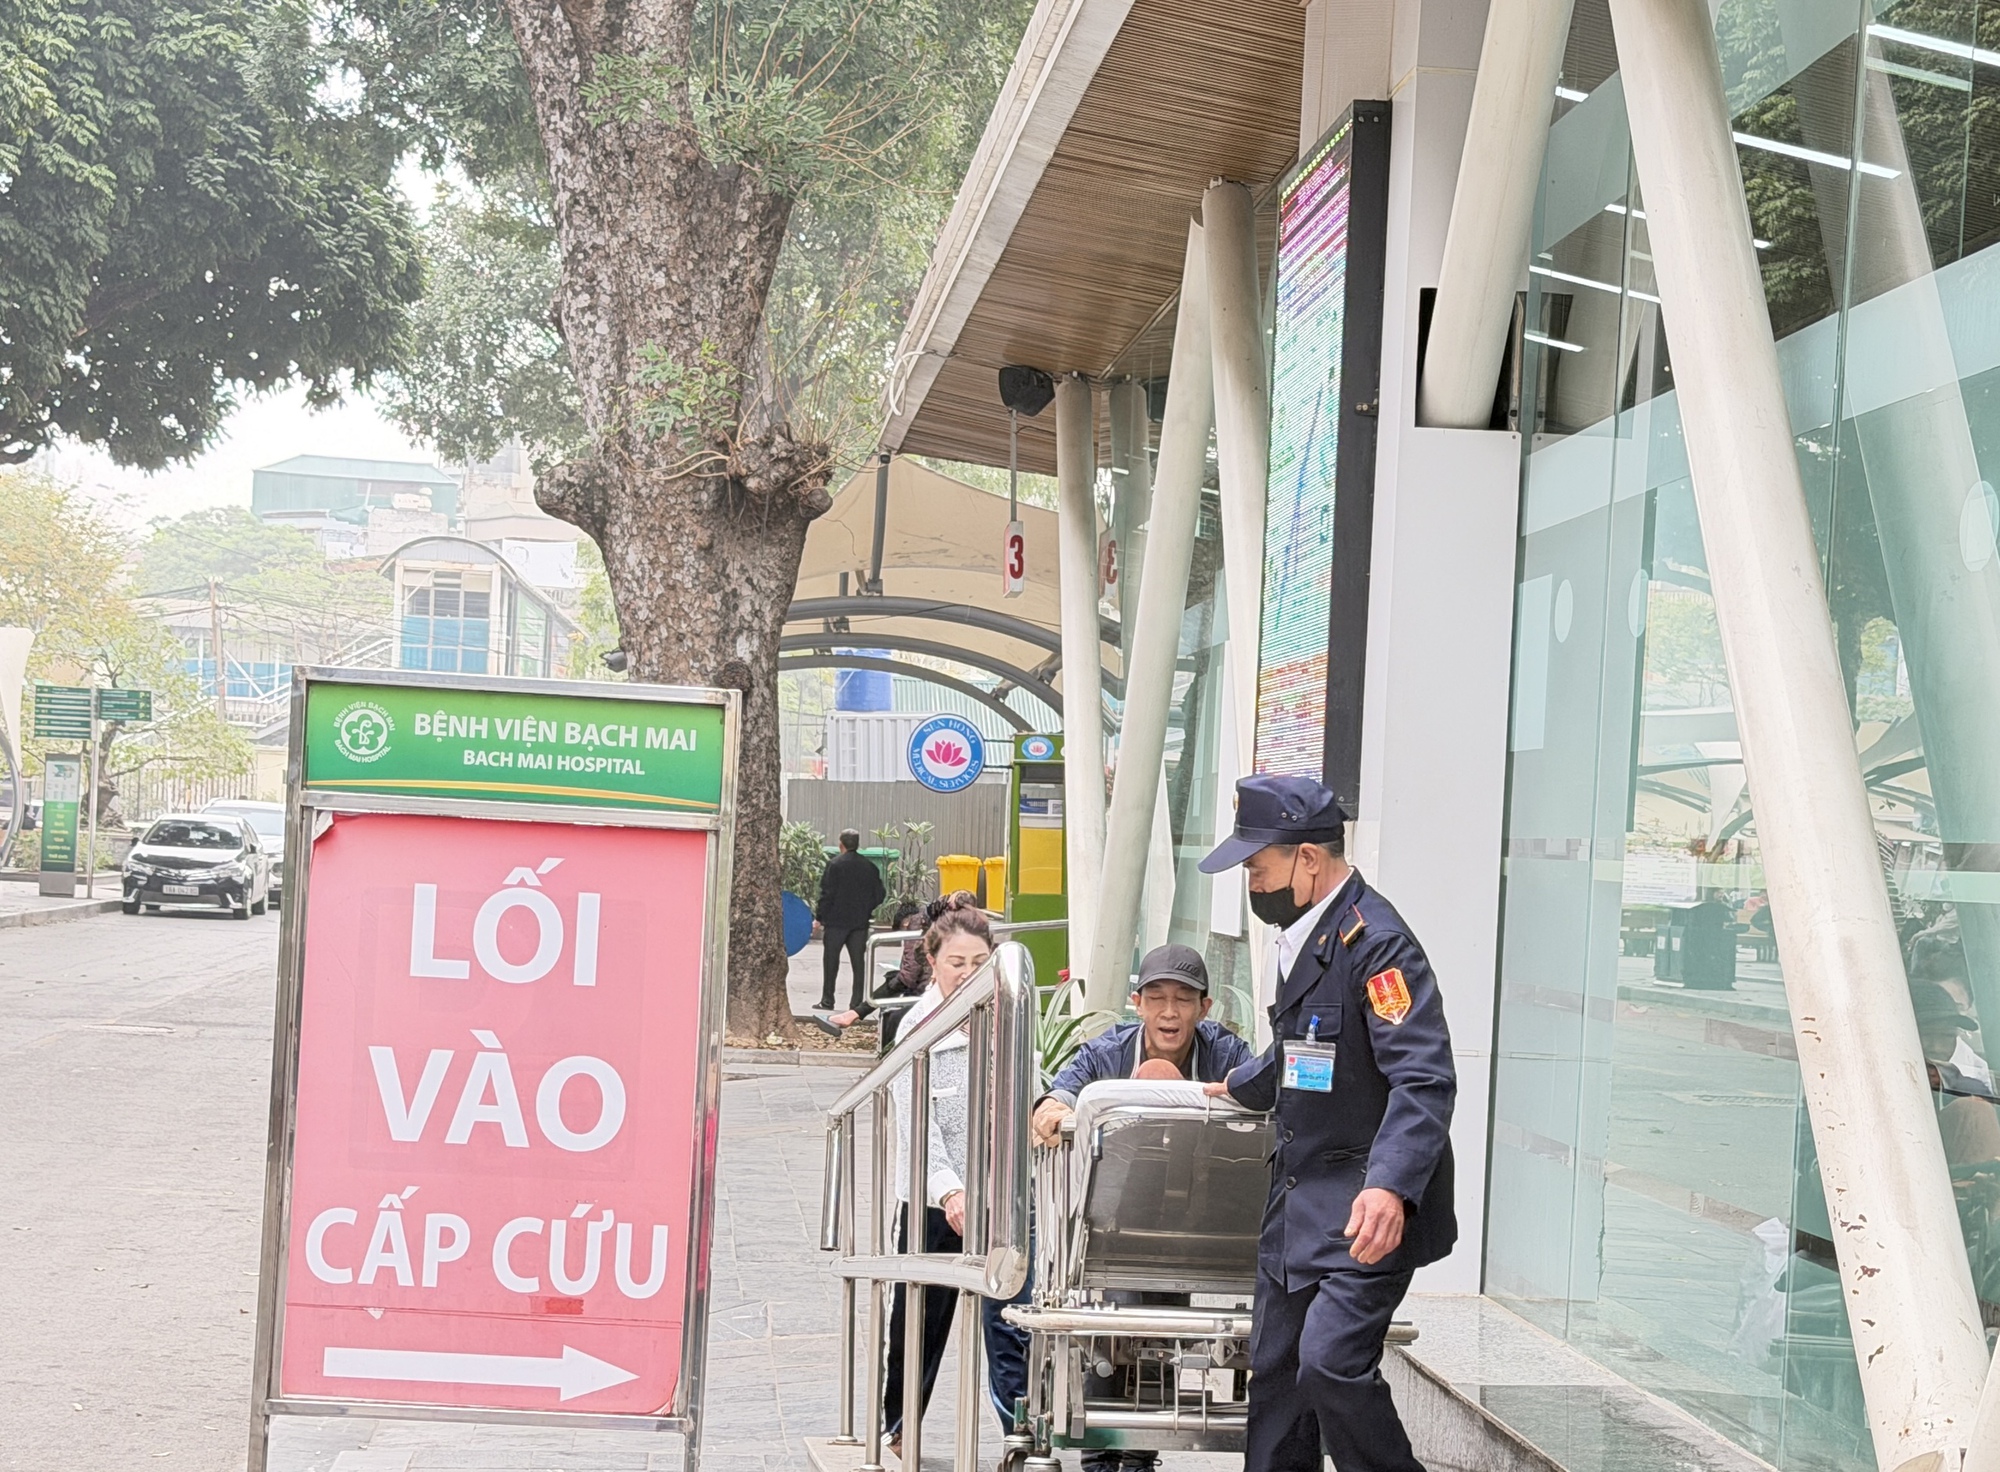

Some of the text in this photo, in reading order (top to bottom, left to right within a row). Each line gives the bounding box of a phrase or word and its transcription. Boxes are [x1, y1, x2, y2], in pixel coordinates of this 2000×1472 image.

[1009, 534, 1024, 579] 3
[385, 716, 396, 731] MAI
[414, 710, 697, 752] BỆNH VIỆN BẠCH MAI
[334, 739, 392, 763] BACH MAI HOSPITAL
[463, 750, 646, 776] BACH MAI HOSPITAL
[912, 748, 980, 788] MEDICAL SERVICES
[409, 857, 601, 987] LỐI
[368, 1029, 627, 1153] VÀO
[305, 1186, 669, 1299] CẤP CỨU
